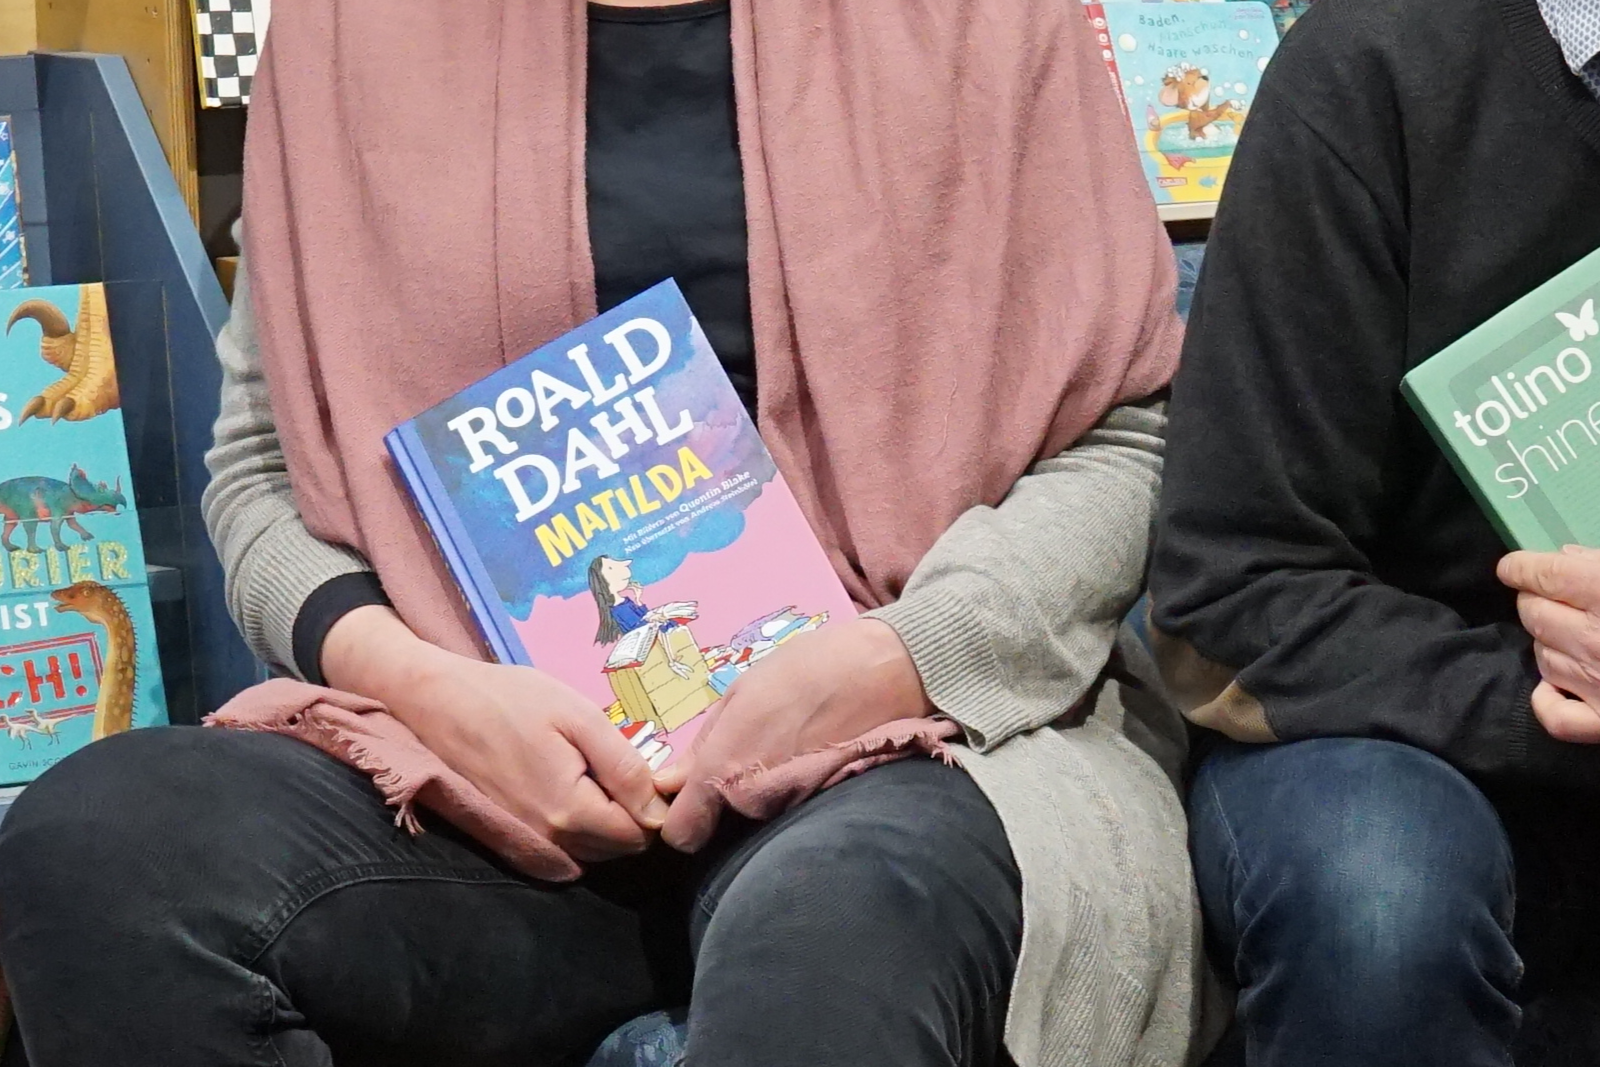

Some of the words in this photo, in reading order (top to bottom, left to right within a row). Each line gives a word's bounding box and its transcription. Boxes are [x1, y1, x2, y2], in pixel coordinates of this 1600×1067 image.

[1147, 43, 1188, 59] Haare
[1191, 42, 1254, 59] waschen
[446, 317, 673, 474] ROALD
[1453, 346, 1593, 447] tolino
[493, 385, 695, 523] DAHL
[534, 446, 714, 567] MATILDA
[622, 533, 638, 545] Mit
[664, 509, 680, 522] von
[679, 486, 722, 513] Quentin
[720, 471, 751, 491] Blake
[675, 515, 691, 527] von
[690, 499, 721, 519] Andreas
[0, 539, 130, 589] RIER
[1, 601, 50, 631] IST
[0, 651, 87, 711] CH!
[9, 760, 39, 770] GAVIN
[42, 756, 62, 767] SCO
